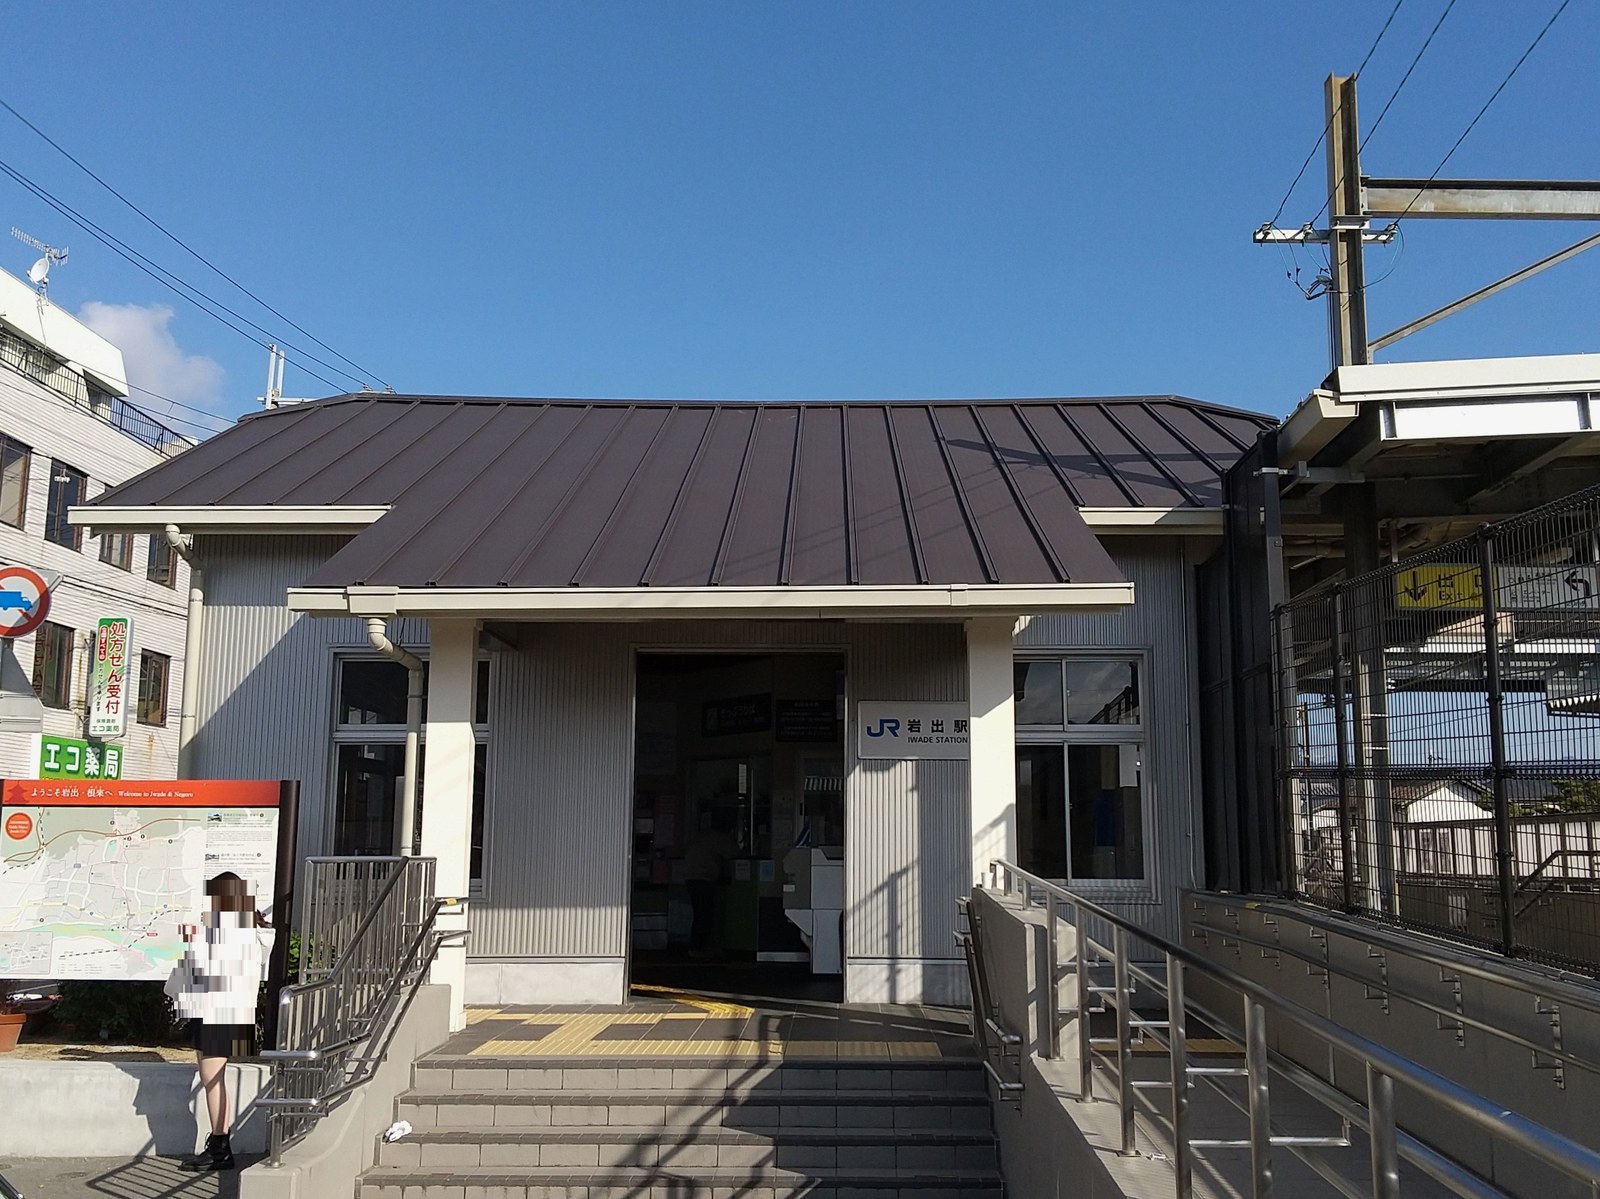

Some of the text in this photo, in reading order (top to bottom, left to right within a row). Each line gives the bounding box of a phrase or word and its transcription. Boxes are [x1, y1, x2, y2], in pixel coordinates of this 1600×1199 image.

[105, 622, 126, 715] 処方せん受付
[866, 718, 900, 737] JR
[907, 719, 968, 733] 岩出駅
[907, 736, 968, 744] IWADE STATION
[44, 743, 119, 778] エコ薬局
